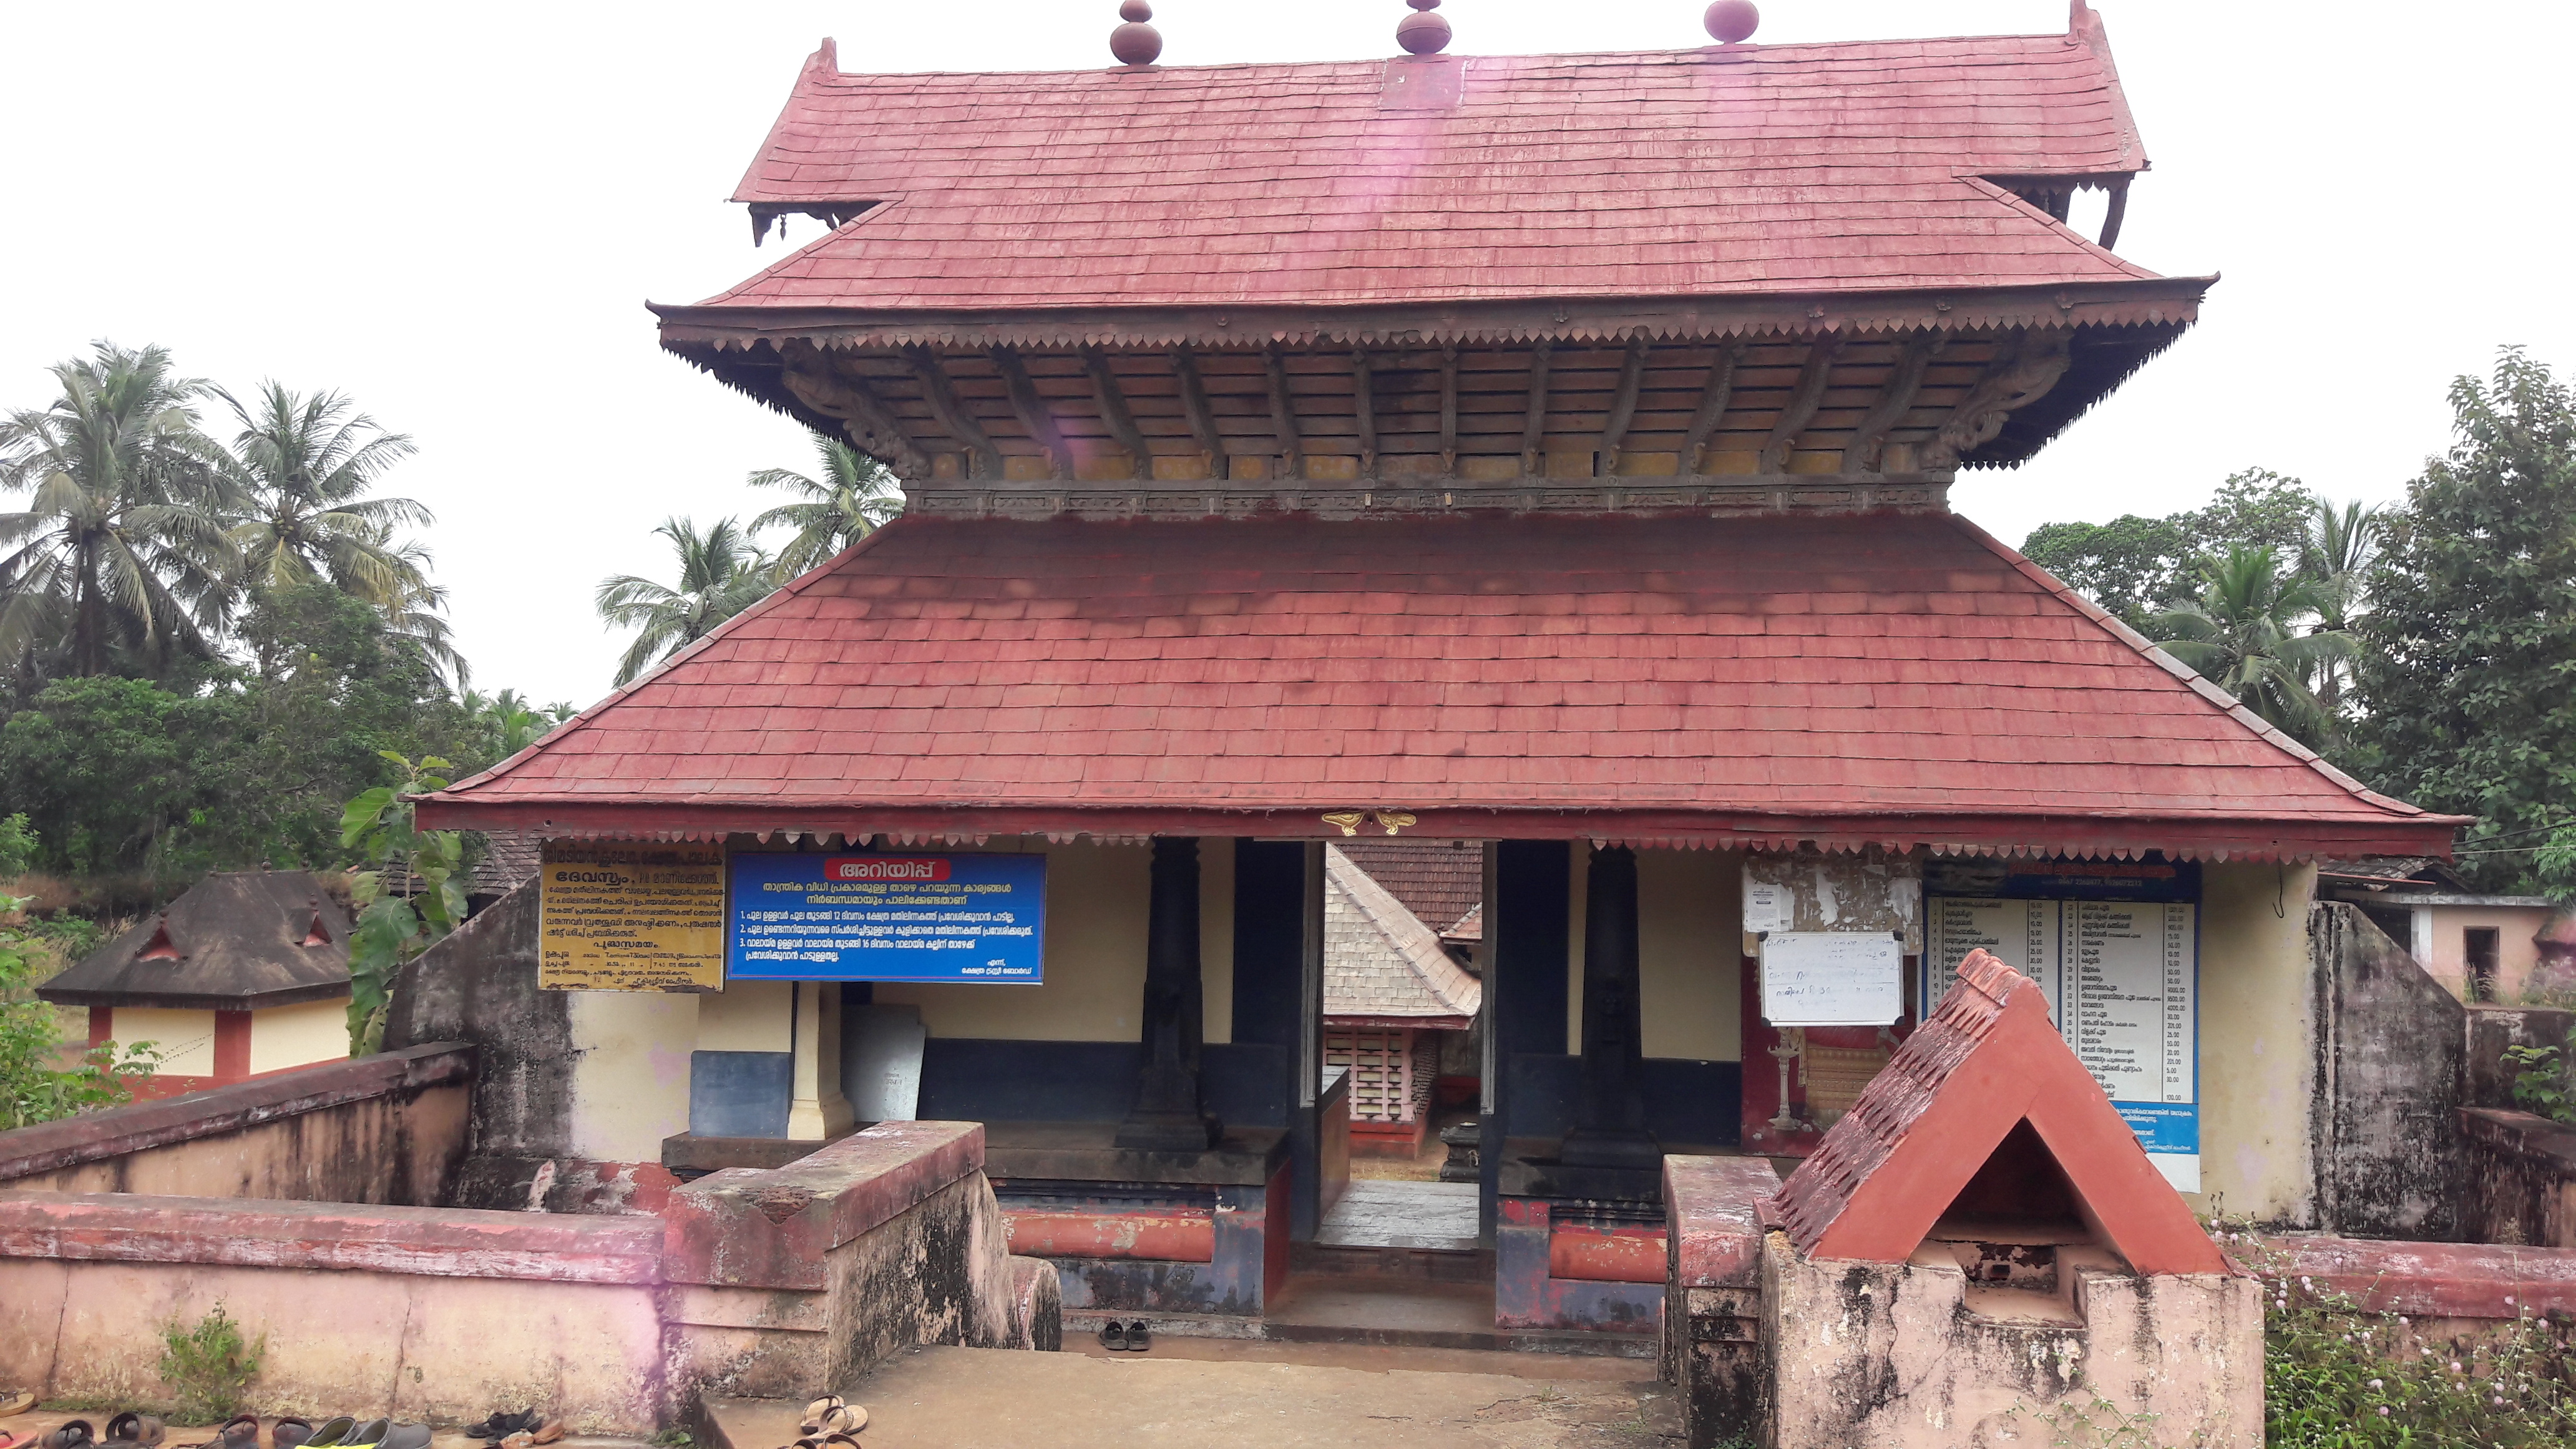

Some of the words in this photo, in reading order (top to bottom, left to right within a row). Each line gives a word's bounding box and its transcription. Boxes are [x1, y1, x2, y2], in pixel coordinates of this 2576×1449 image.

[839, 861, 936, 878] അറിയിപ്പ്
[763, 882, 803, 893] താന്ത്രിക
[806, 882, 829, 891] വിധി
[831, 882, 887, 894] പ്രകാരമുള്ള
[890, 884, 917, 892] താഴെ
[919, 883, 961, 894] പറയുന്ന
[964, 883, 1012, 894] കാര്യങ്ങൾ
[806, 894, 883, 906] നിർബന്ധമായും
[886, 895, 968, 905] പാലിക്കേണ്ടതാണ്
[740, 910, 746, 919] 1.
[747, 911, 762, 920] പുല
[763, 910, 789, 921] ഉള്ളവർ
[790, 912, 805, 920] പുല
[806, 910, 832, 922] തുടങ്ങി
[842, 911, 865, 920] ദിവസം
[866, 911, 889, 922] ക്ഷേത്ര
[939, 911, 992, 922] പ്രവേശിക്കുവാൻ
[993, 912, 1015, 923] പാടില്ല.
[740, 924, 746, 933] 2.
[747, 925, 762, 934] പുല
[895, 925, 934, 936] കുളിക്കാതെ
[739, 938, 746, 947] 3.
[747, 938, 776, 947] വാലായ്മ
[778, 938, 803, 949] ഉള്ളവർ
[804, 938, 833, 947] വാലായ്മ
[835, 938, 861, 949] തുടങ്ങി
[862, 939, 869, 947] 16
[871, 939, 894, 948] ദിവസം
[895, 939, 925, 949] വാലായ്മ
[746, 950, 798, 961] പ്രവേശിക്കുവാൻ
[800, 952, 839, 962] പാടുള്ളതല്ല.
